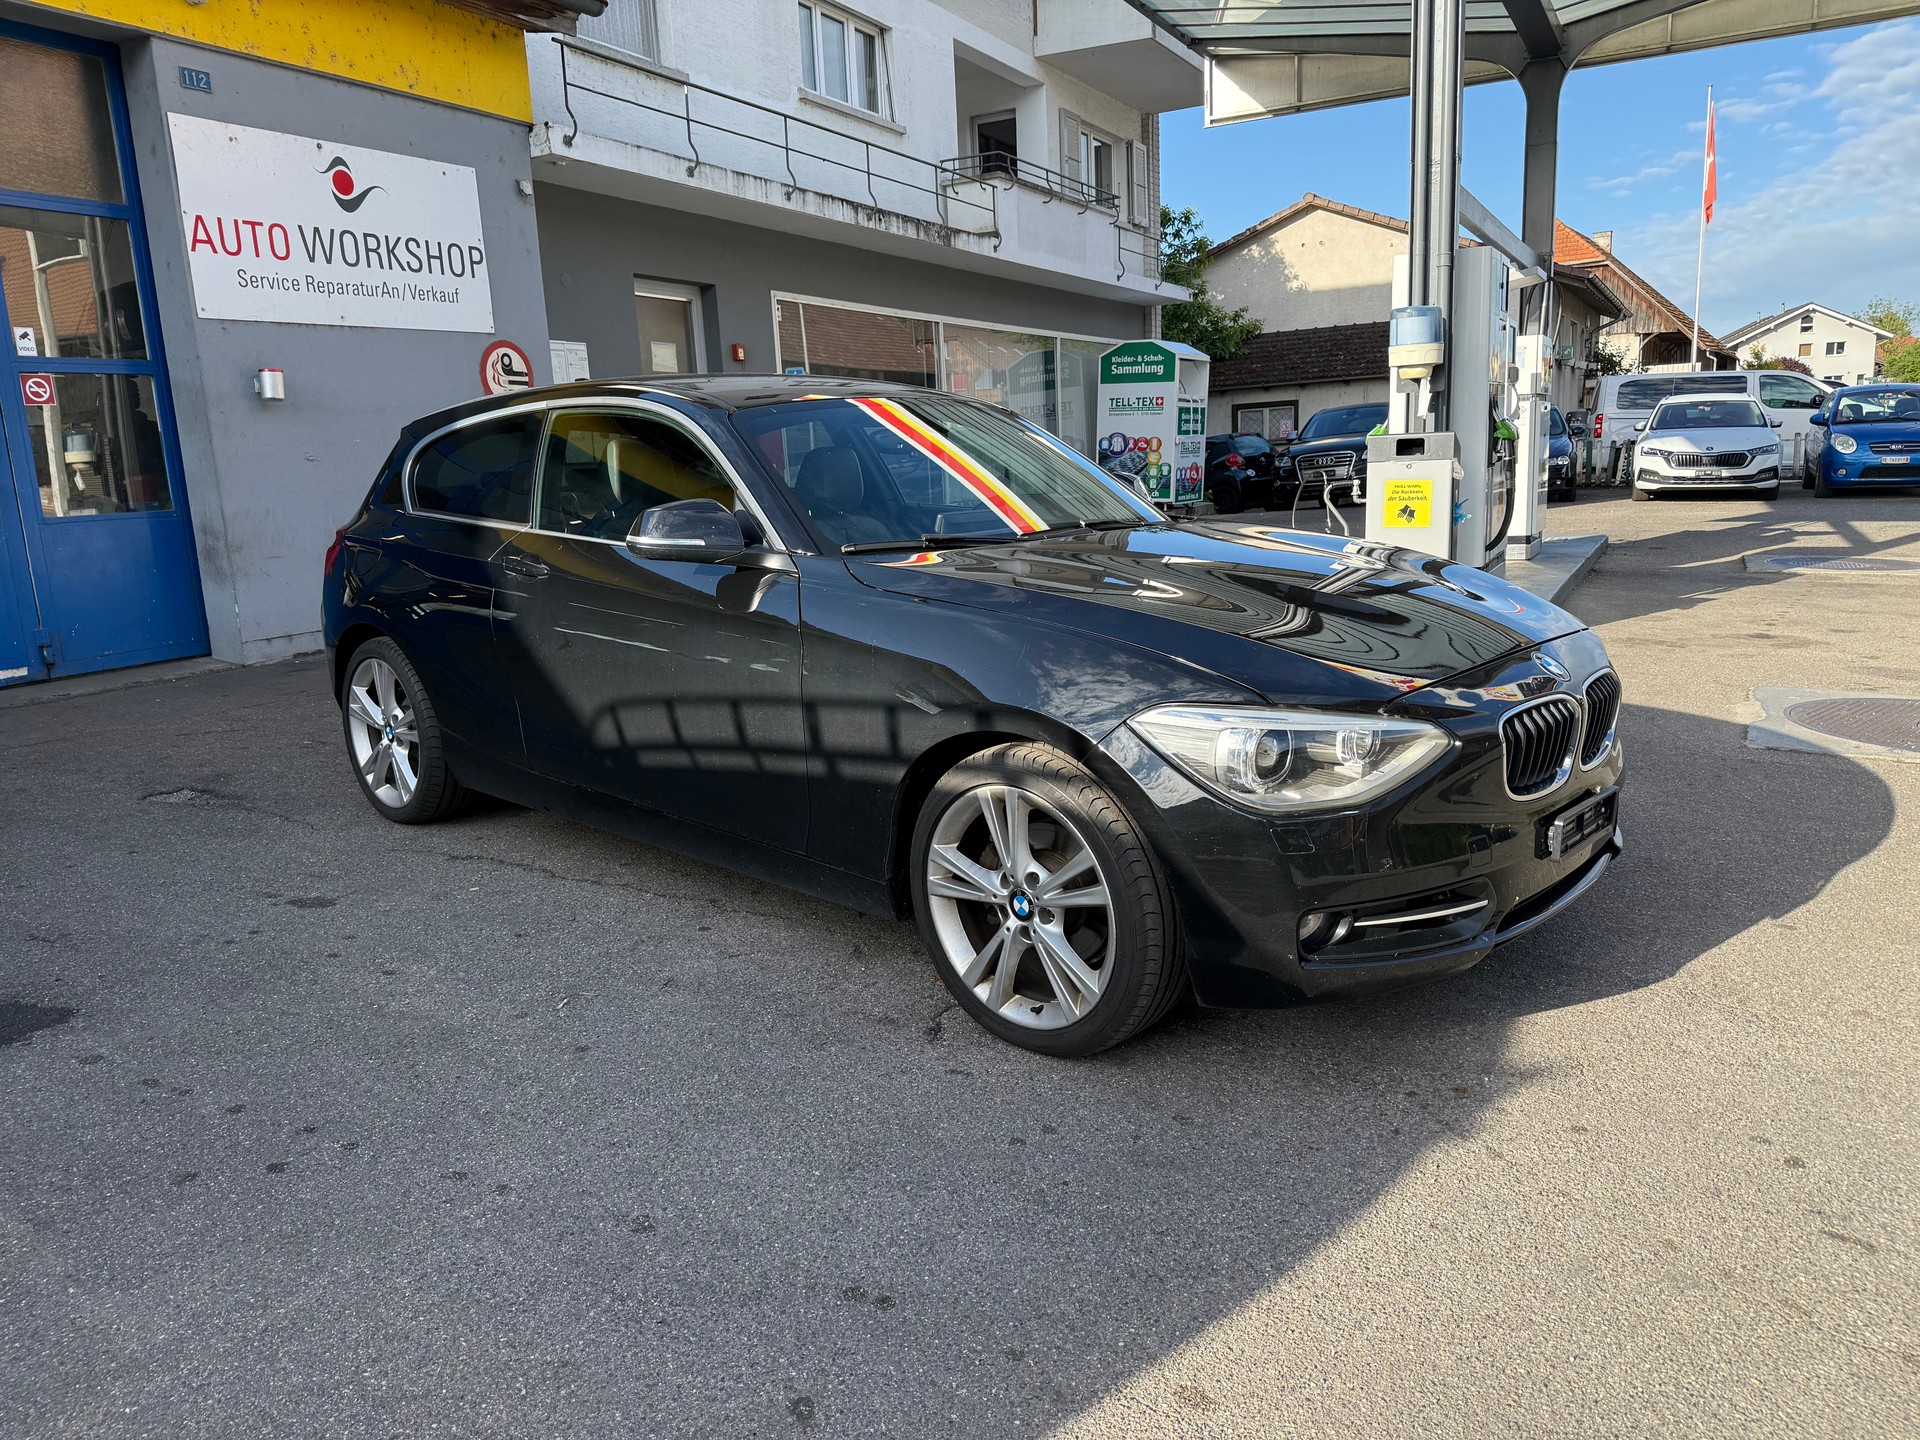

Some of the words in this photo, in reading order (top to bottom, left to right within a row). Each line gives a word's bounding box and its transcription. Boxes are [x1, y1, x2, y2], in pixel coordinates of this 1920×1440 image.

[184, 70, 208, 89] 112
[190, 214, 291, 261] AUTO
[297, 224, 485, 279] WORKSHOP
[236, 268, 301, 292] Service
[1111, 355, 1136, 363] Kleider-
[1143, 354, 1165, 362] Schuh-
[1111, 362, 1164, 375] Sammlung
[1109, 396, 1155, 407] TELL-TEX
